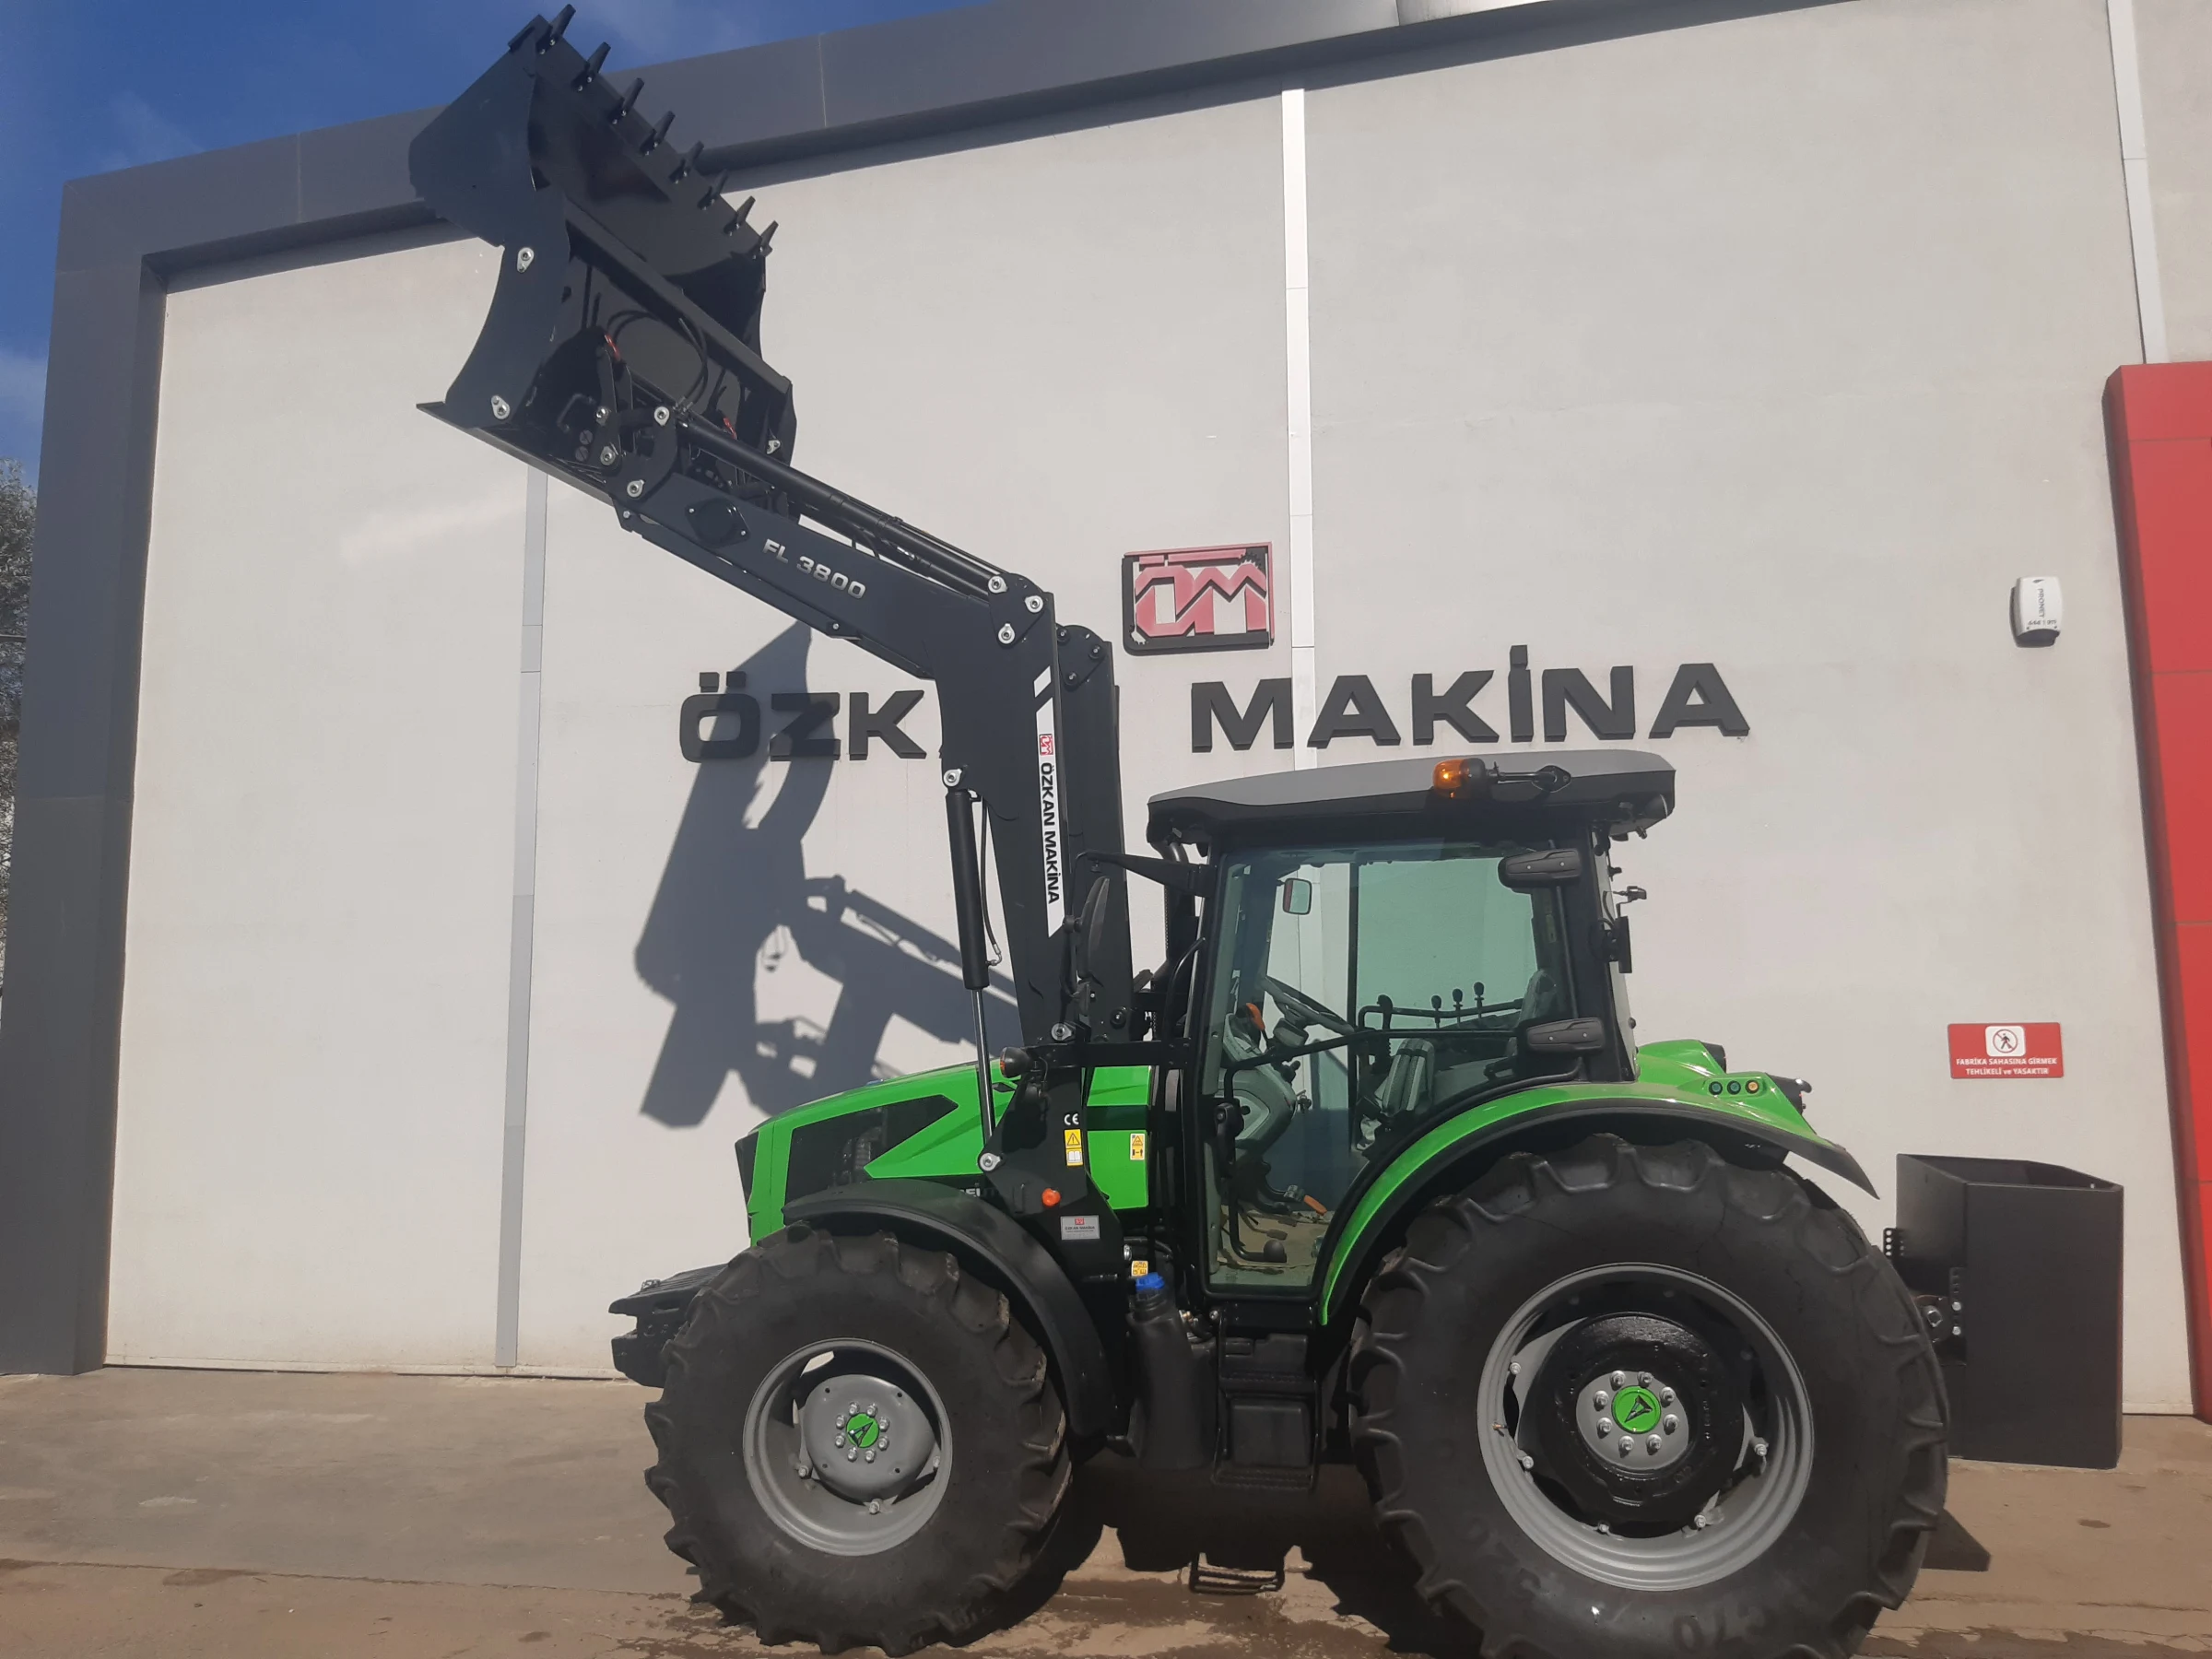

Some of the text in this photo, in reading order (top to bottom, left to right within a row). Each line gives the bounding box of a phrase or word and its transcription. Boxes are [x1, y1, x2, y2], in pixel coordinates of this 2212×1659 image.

[762, 538, 866, 599] FL 3800
[2037, 588, 2045, 618] PRONET
[679, 645, 1750, 761] ÖZK MAKİNA
[1041, 762, 1061, 904] ÖZKAN MAKİNA
[1956, 1057, 1987, 1065] FABRİKA
[1966, 1067, 2002, 1076] TEHLİKELİ
[1064, 1113, 1079, 1125] CE
